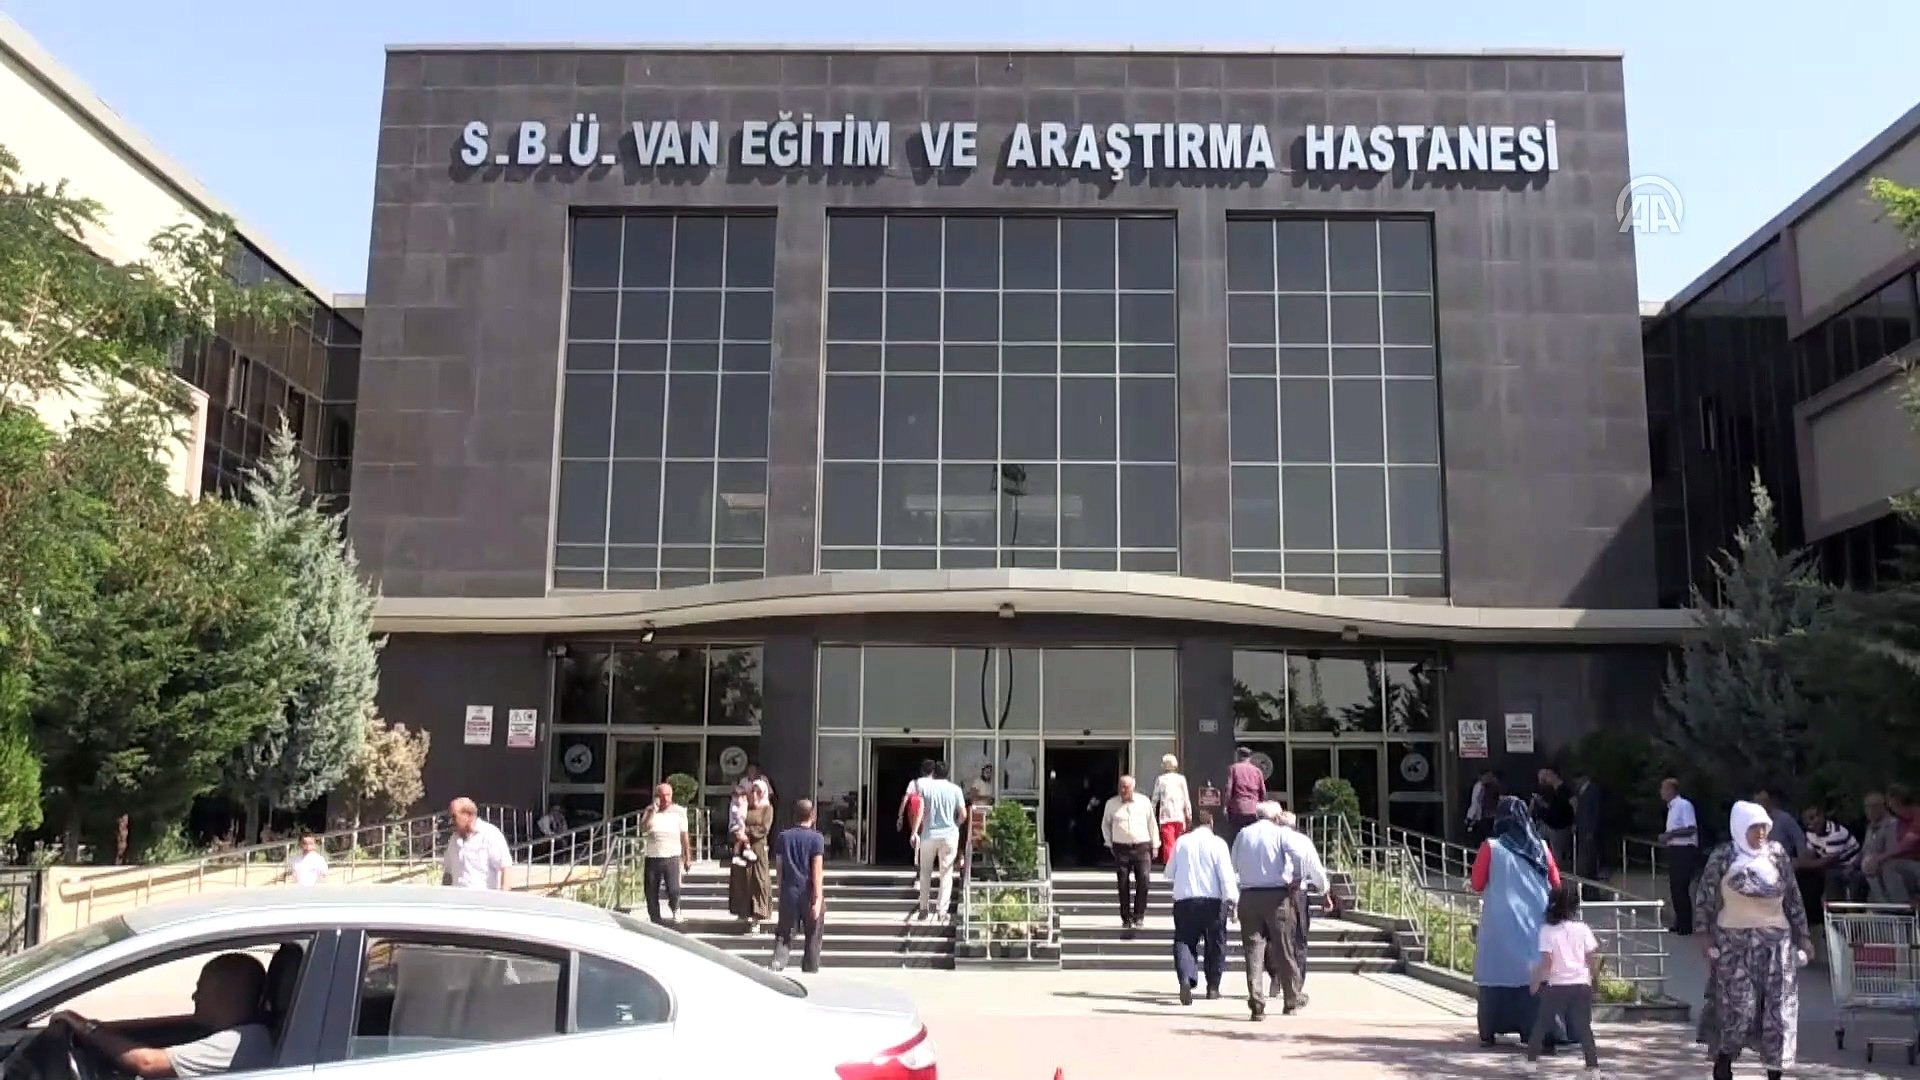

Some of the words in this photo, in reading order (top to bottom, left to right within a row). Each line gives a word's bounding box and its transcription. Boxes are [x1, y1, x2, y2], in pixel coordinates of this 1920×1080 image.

[461, 113, 616, 165] S.B.Ü.
[632, 121, 719, 166] VAN
[741, 110, 890, 167] EĞİTİM
[921, 122, 978, 167] VE
[1006, 122, 1276, 180] ARAŞTIRMA
[1306, 119, 1560, 172] HASTANESİ
